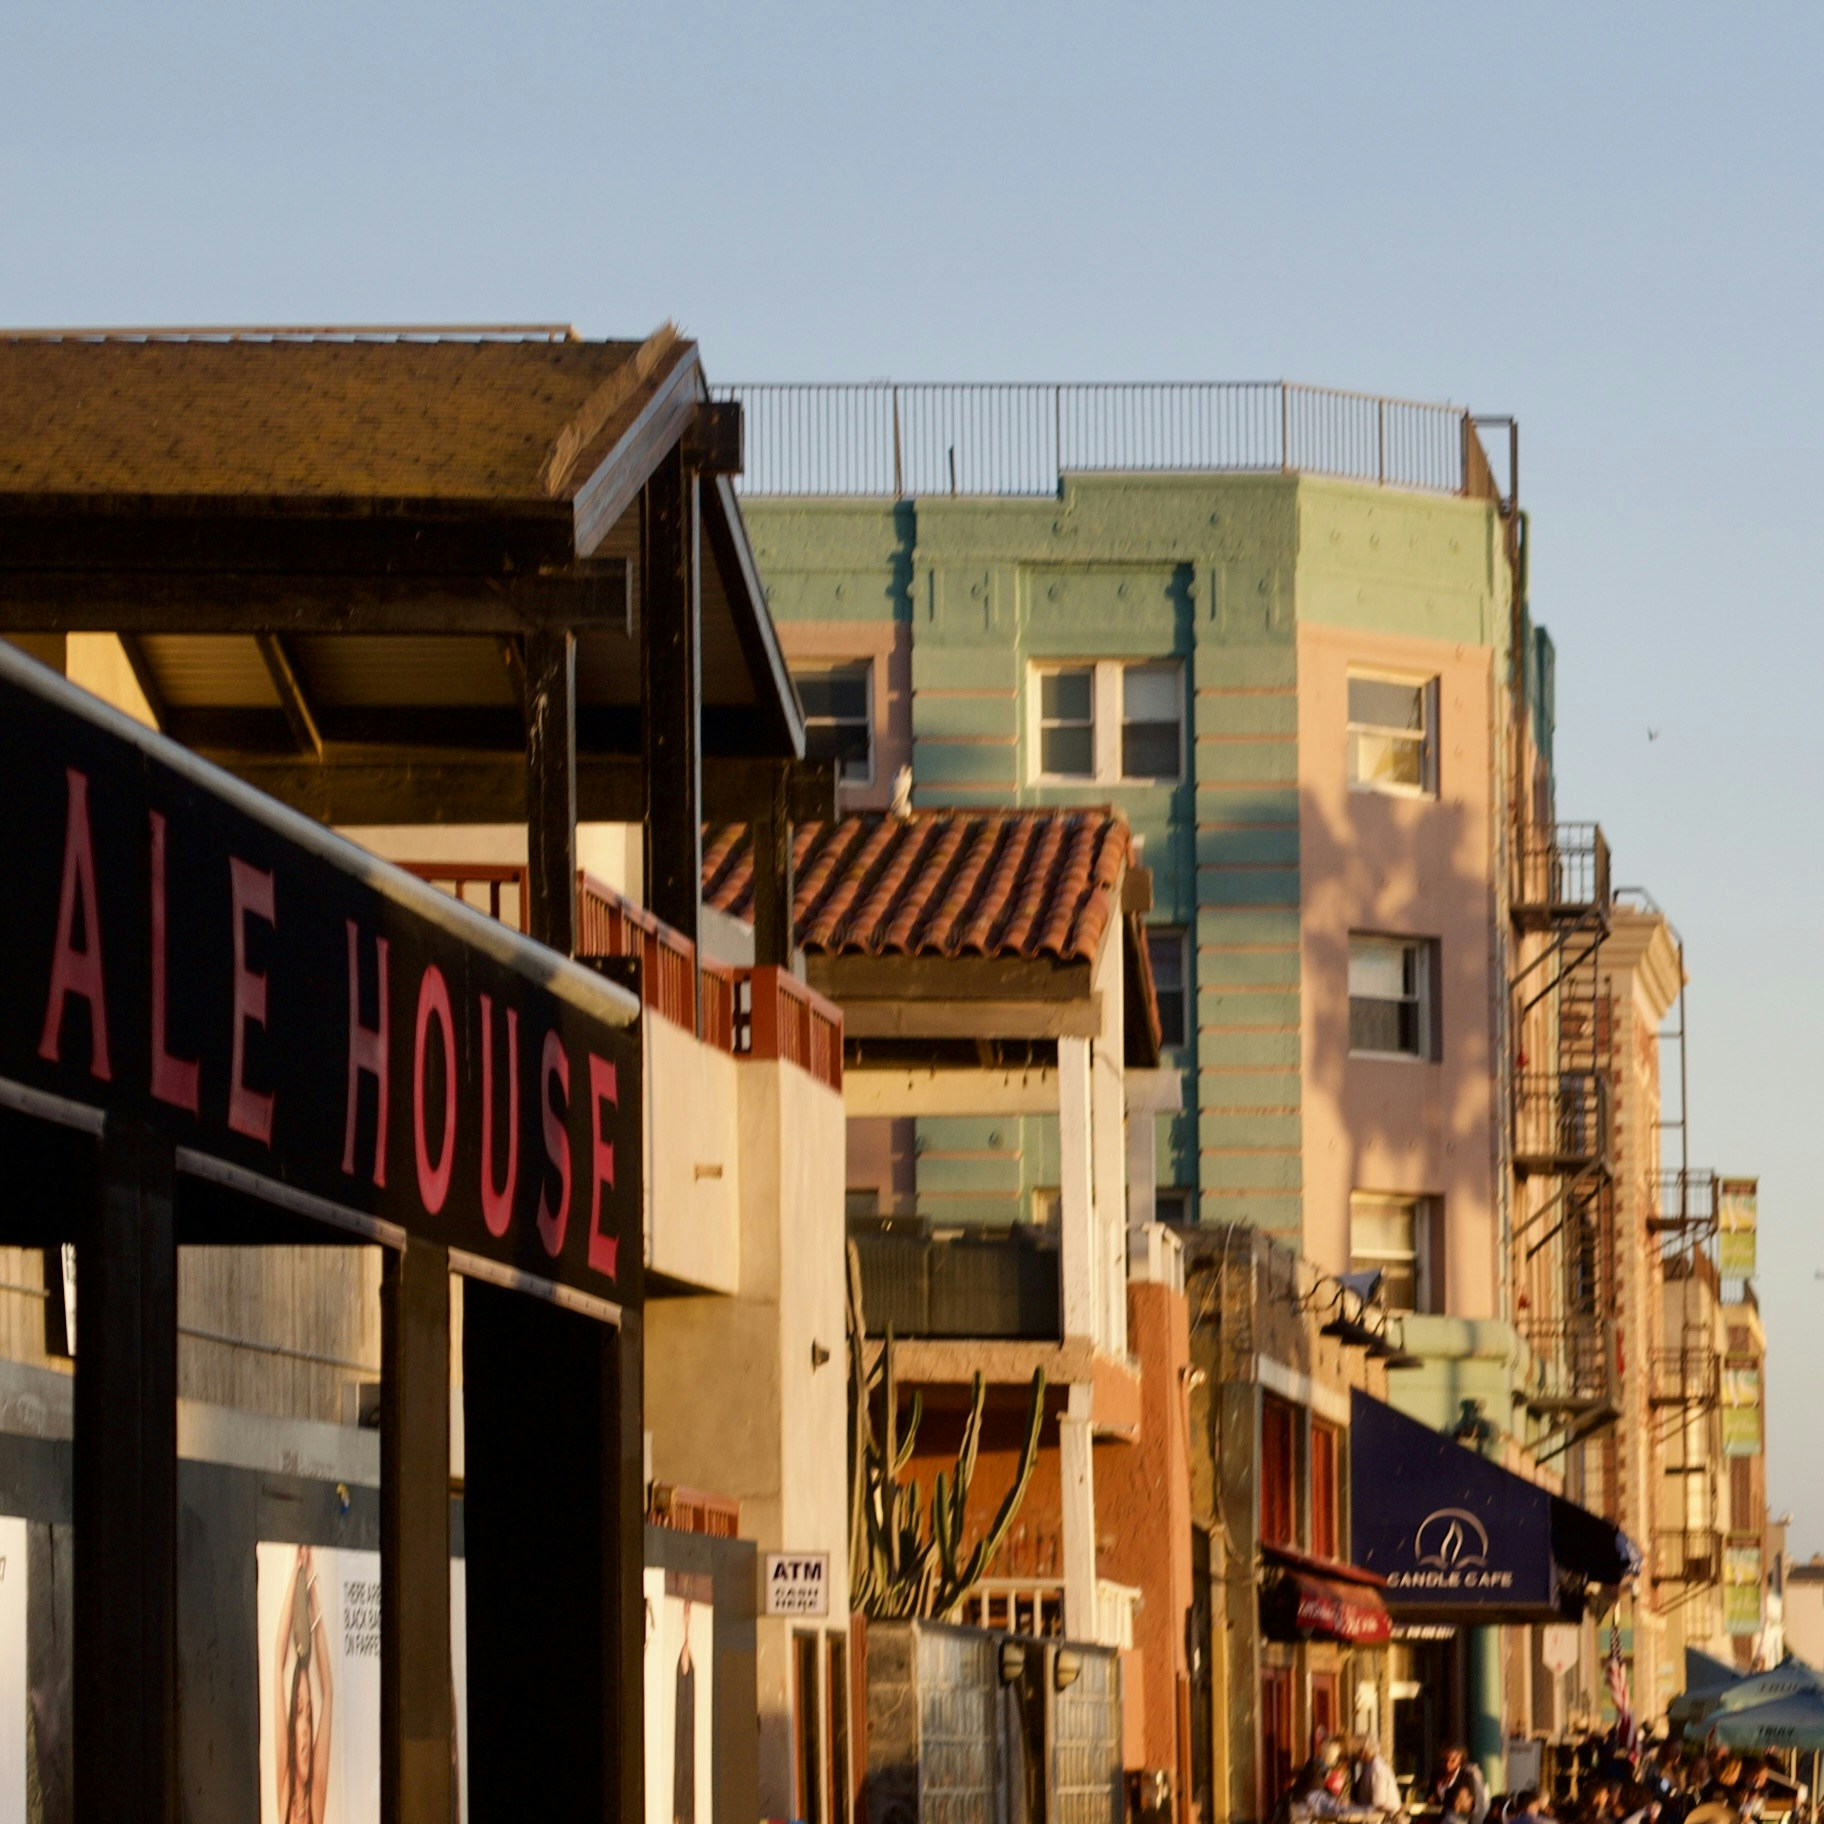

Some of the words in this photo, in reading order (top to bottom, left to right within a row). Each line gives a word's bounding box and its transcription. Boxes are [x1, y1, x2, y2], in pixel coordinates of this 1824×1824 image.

[38, 765, 276, 1150] ALE
[341, 917, 621, 1287] HOUSE
[773, 1561, 822, 1581] ATM
[1387, 1570, 1460, 1589] CANDLE
[1464, 1570, 1513, 1589] CAFE
